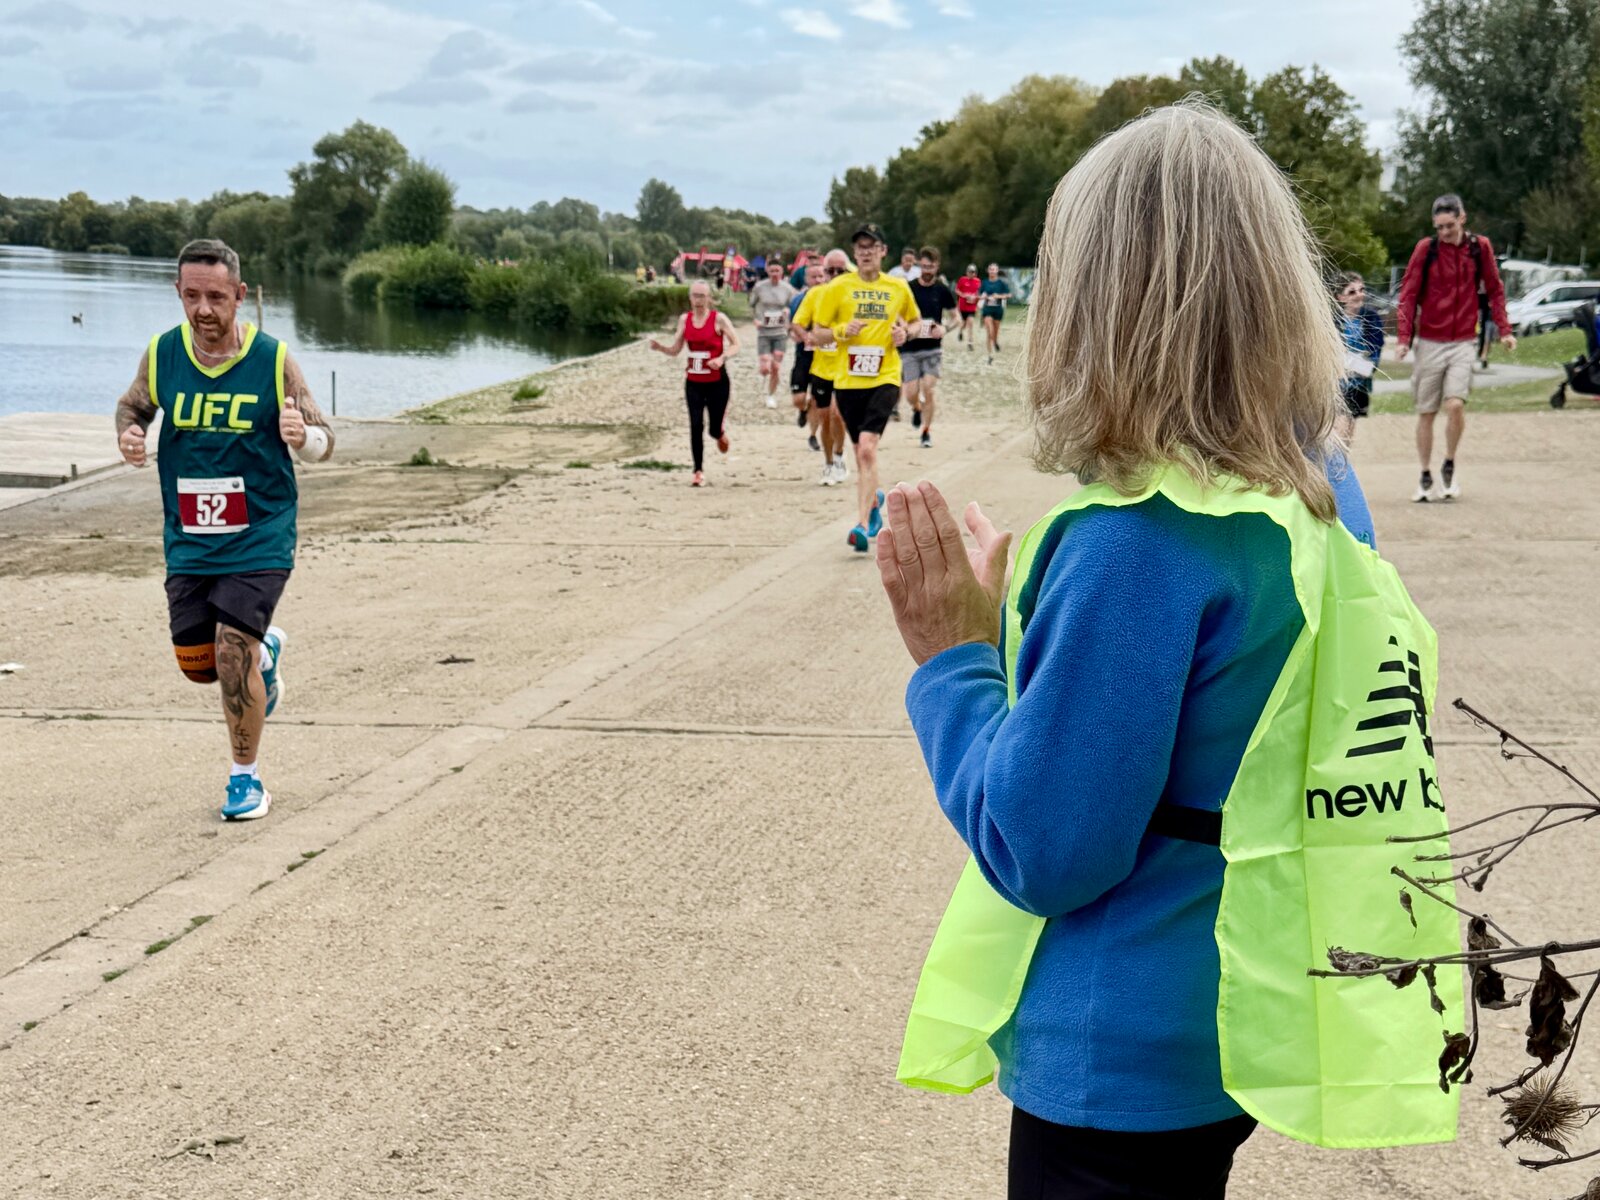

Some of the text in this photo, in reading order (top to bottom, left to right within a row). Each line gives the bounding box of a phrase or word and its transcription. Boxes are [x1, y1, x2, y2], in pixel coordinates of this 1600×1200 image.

[853, 290, 891, 301] STEVE
[173, 392, 259, 429] UFC
[196, 494, 228, 526] 52
[1306, 779, 1408, 819] new
